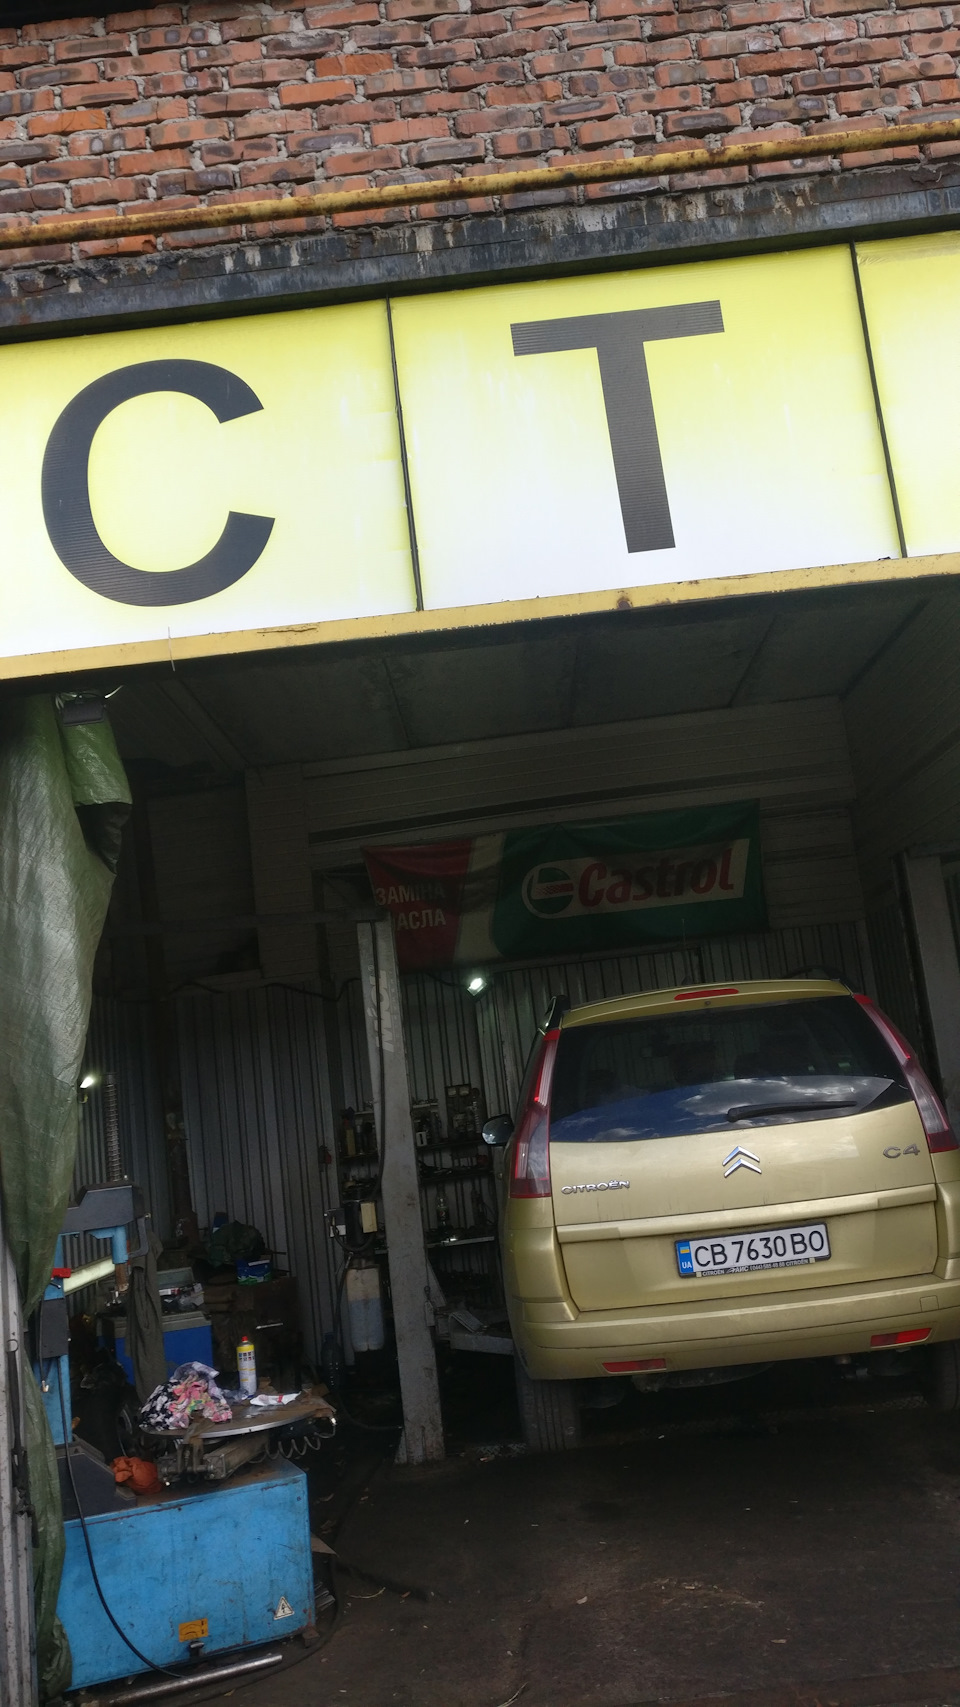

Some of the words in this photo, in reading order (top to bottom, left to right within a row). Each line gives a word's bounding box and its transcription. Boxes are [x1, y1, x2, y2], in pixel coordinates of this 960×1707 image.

[577, 847, 734, 908] Castrol
[394, 908, 447, 931] АСЛА
[883, 1143, 921, 1159] C4
[561, 1180, 631, 1195] CITROËN
[681, 1261, 693, 1269] UA
